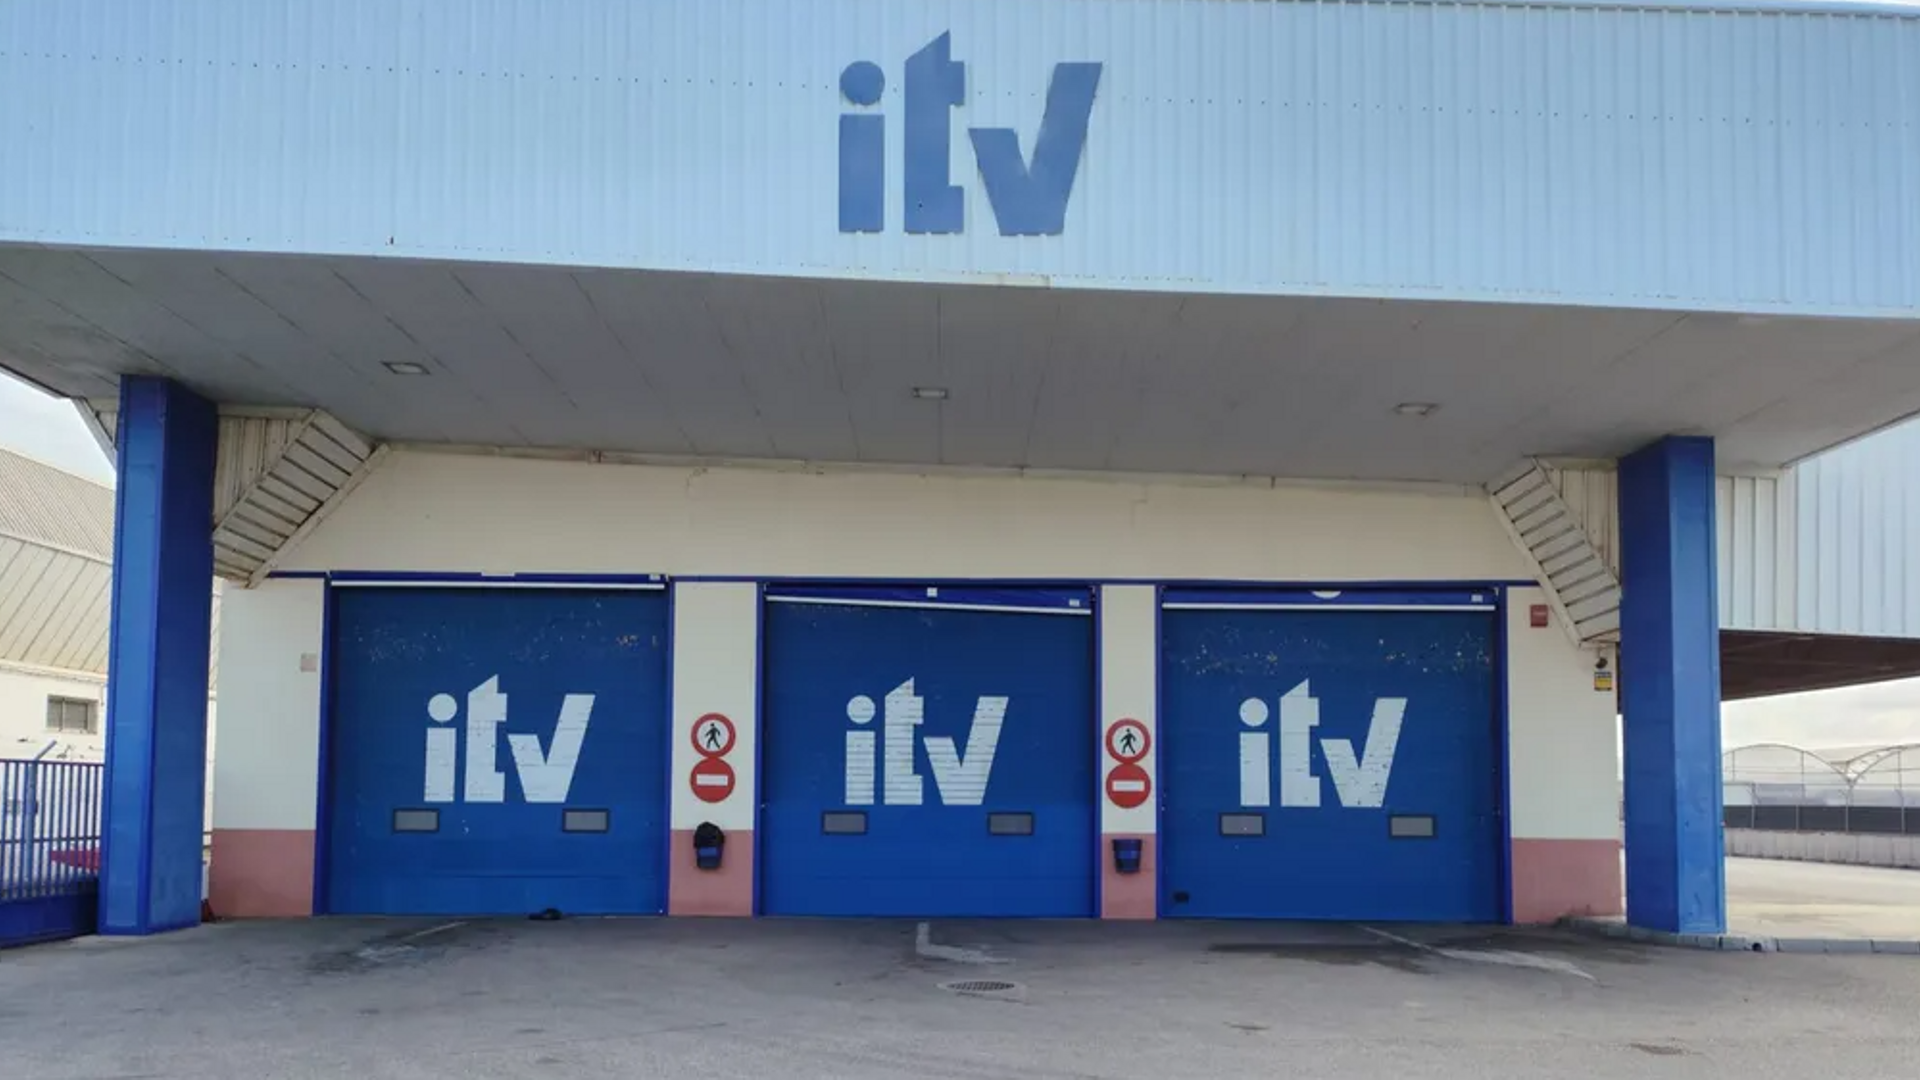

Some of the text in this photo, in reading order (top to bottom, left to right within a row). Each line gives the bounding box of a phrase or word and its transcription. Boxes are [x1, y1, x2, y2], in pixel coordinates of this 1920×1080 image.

[839, 29, 1102, 236] itv
[424, 674, 595, 803] itv
[844, 677, 1009, 806] itv
[1239, 678, 1407, 808] itv
